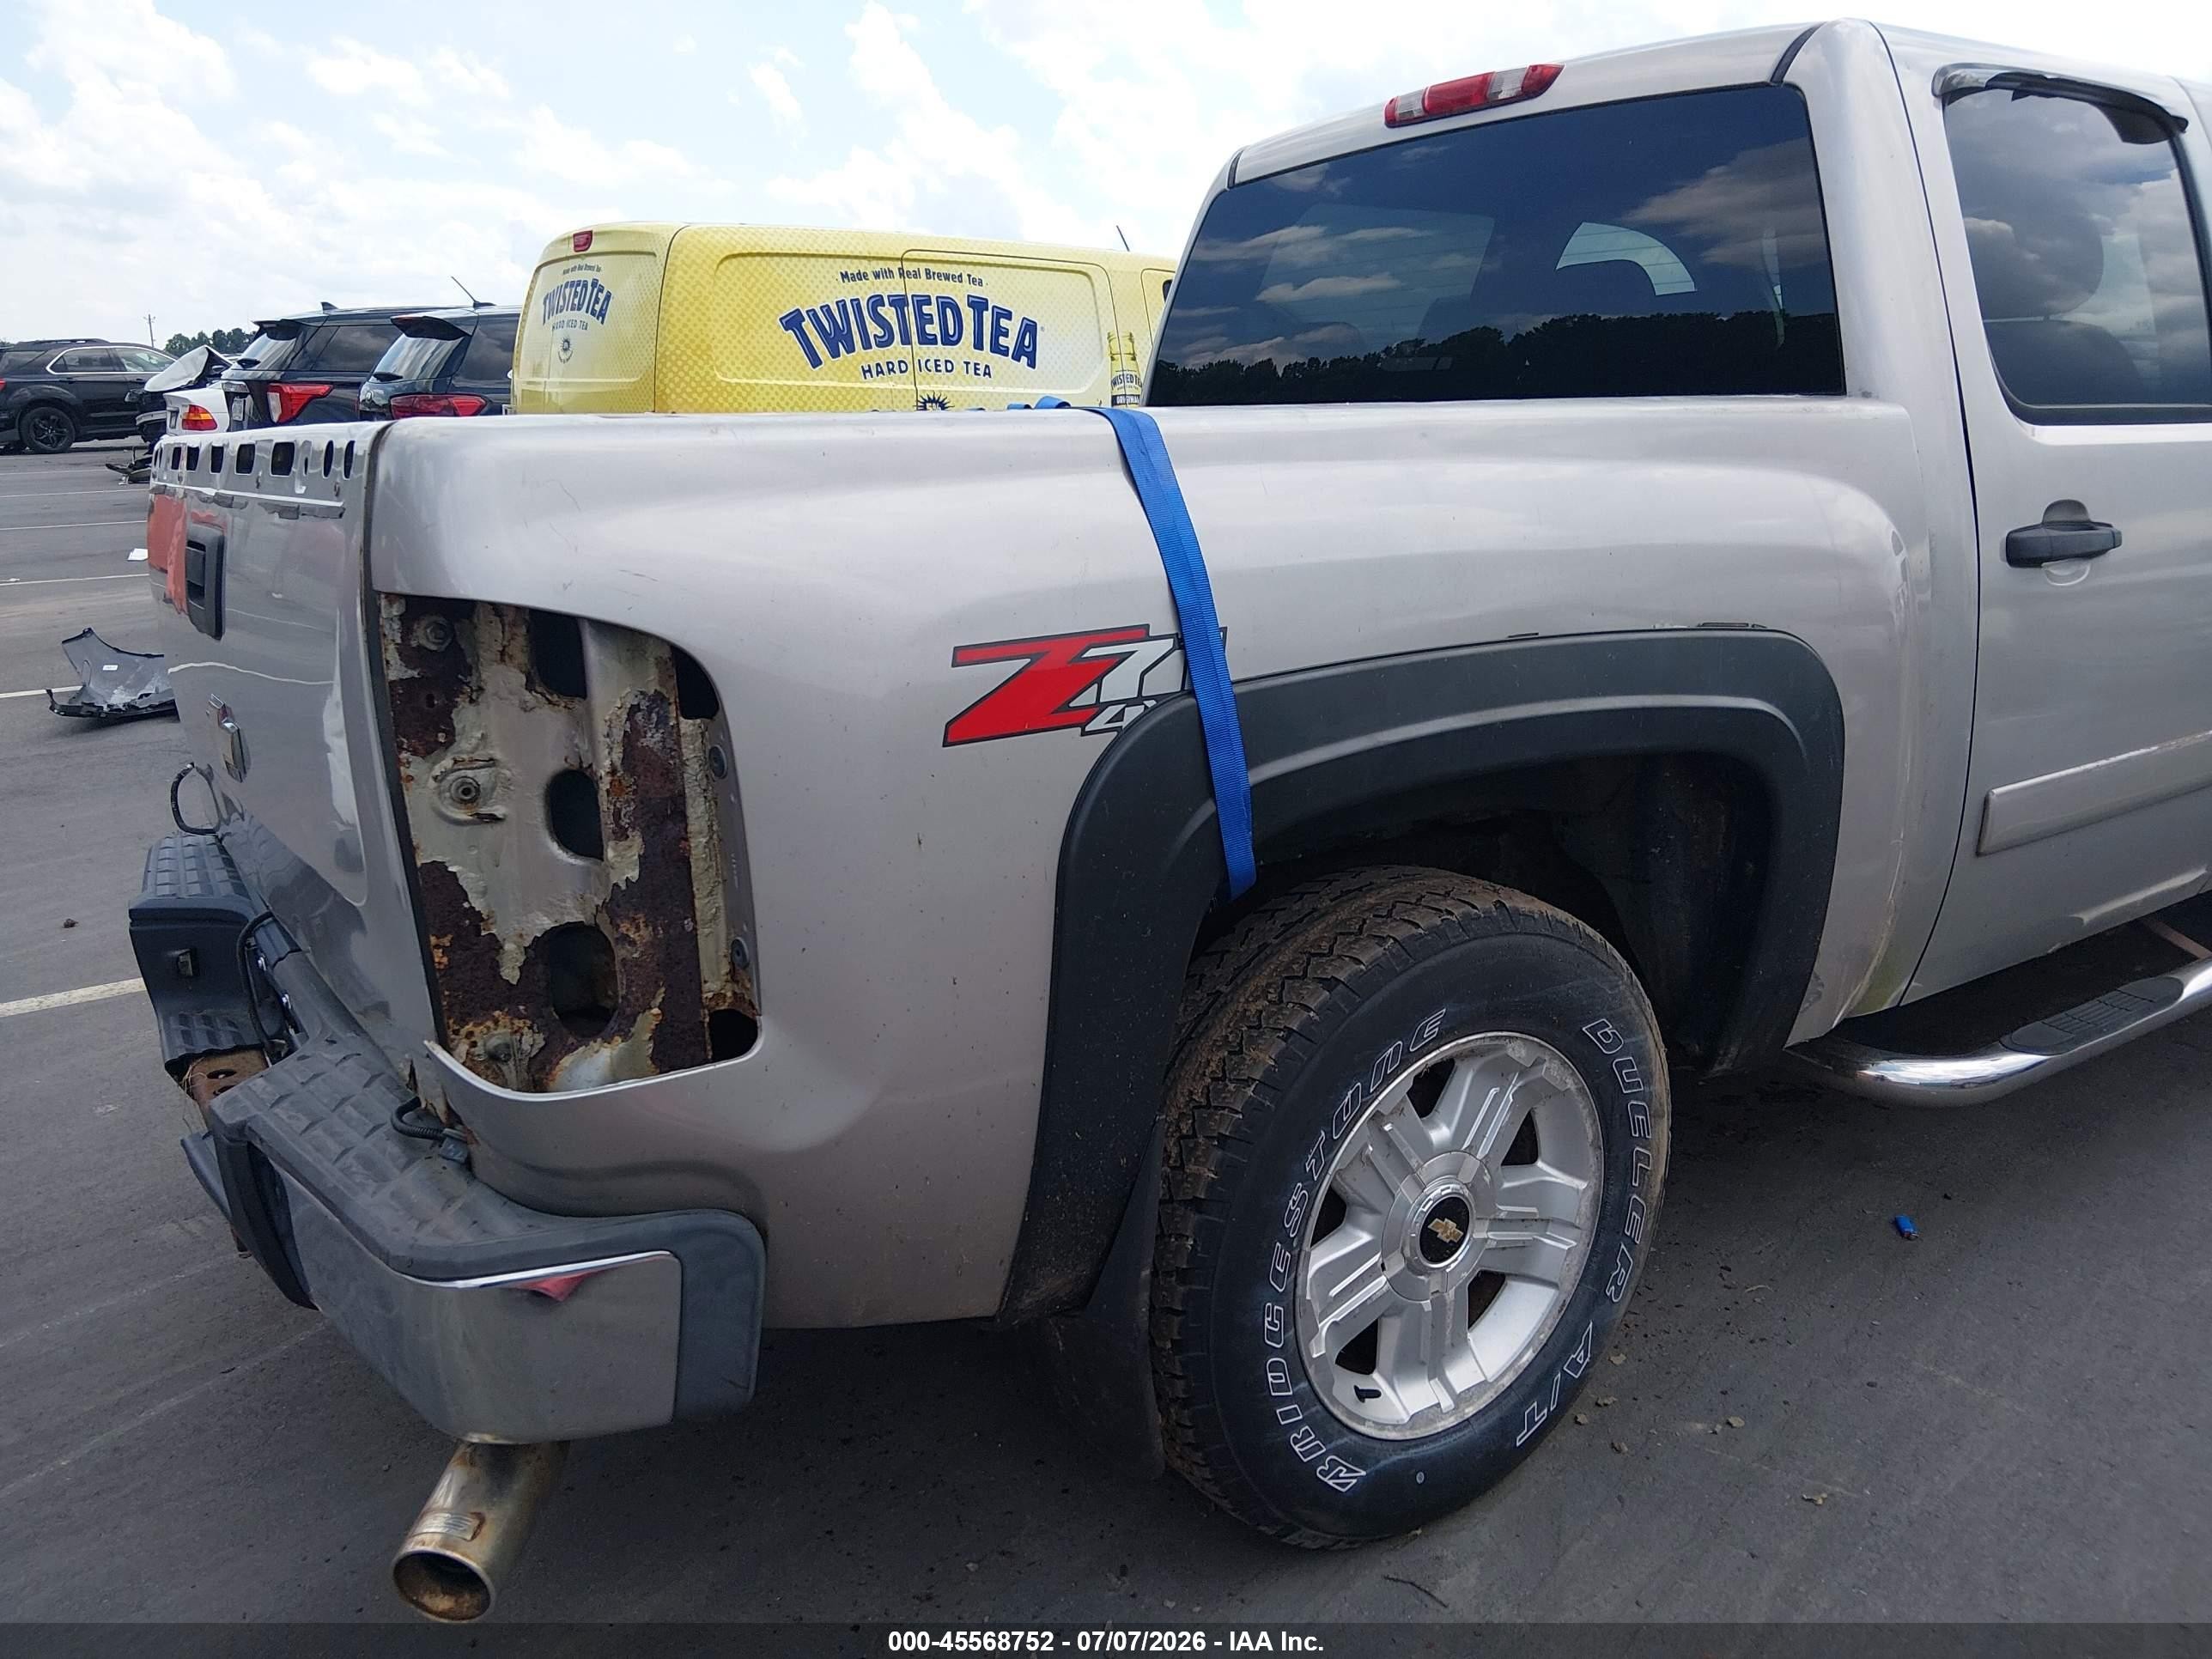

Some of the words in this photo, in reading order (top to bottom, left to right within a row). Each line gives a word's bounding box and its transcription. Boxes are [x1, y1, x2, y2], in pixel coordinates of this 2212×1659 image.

[543, 279, 588, 325] TWISTED
[586, 277, 612, 325] TEA
[840, 270, 869, 283] Made
[872, 267, 895, 280] with
[898, 267, 921, 279] Real
[925, 268, 963, 283] Brewed
[967, 273, 983, 287] Tea
[779, 294, 963, 370] TWISTED
[967, 294, 1039, 370] TEA
[861, 359, 908, 380] HARD
[918, 358, 954, 374] ICED
[963, 361, 992, 379] TEA
[1582, 1018, 1652, 1304] DUELER
[1265, 1008, 1447, 1492] BRIDGESTONE
[1516, 1320, 1593, 1447] A/T
